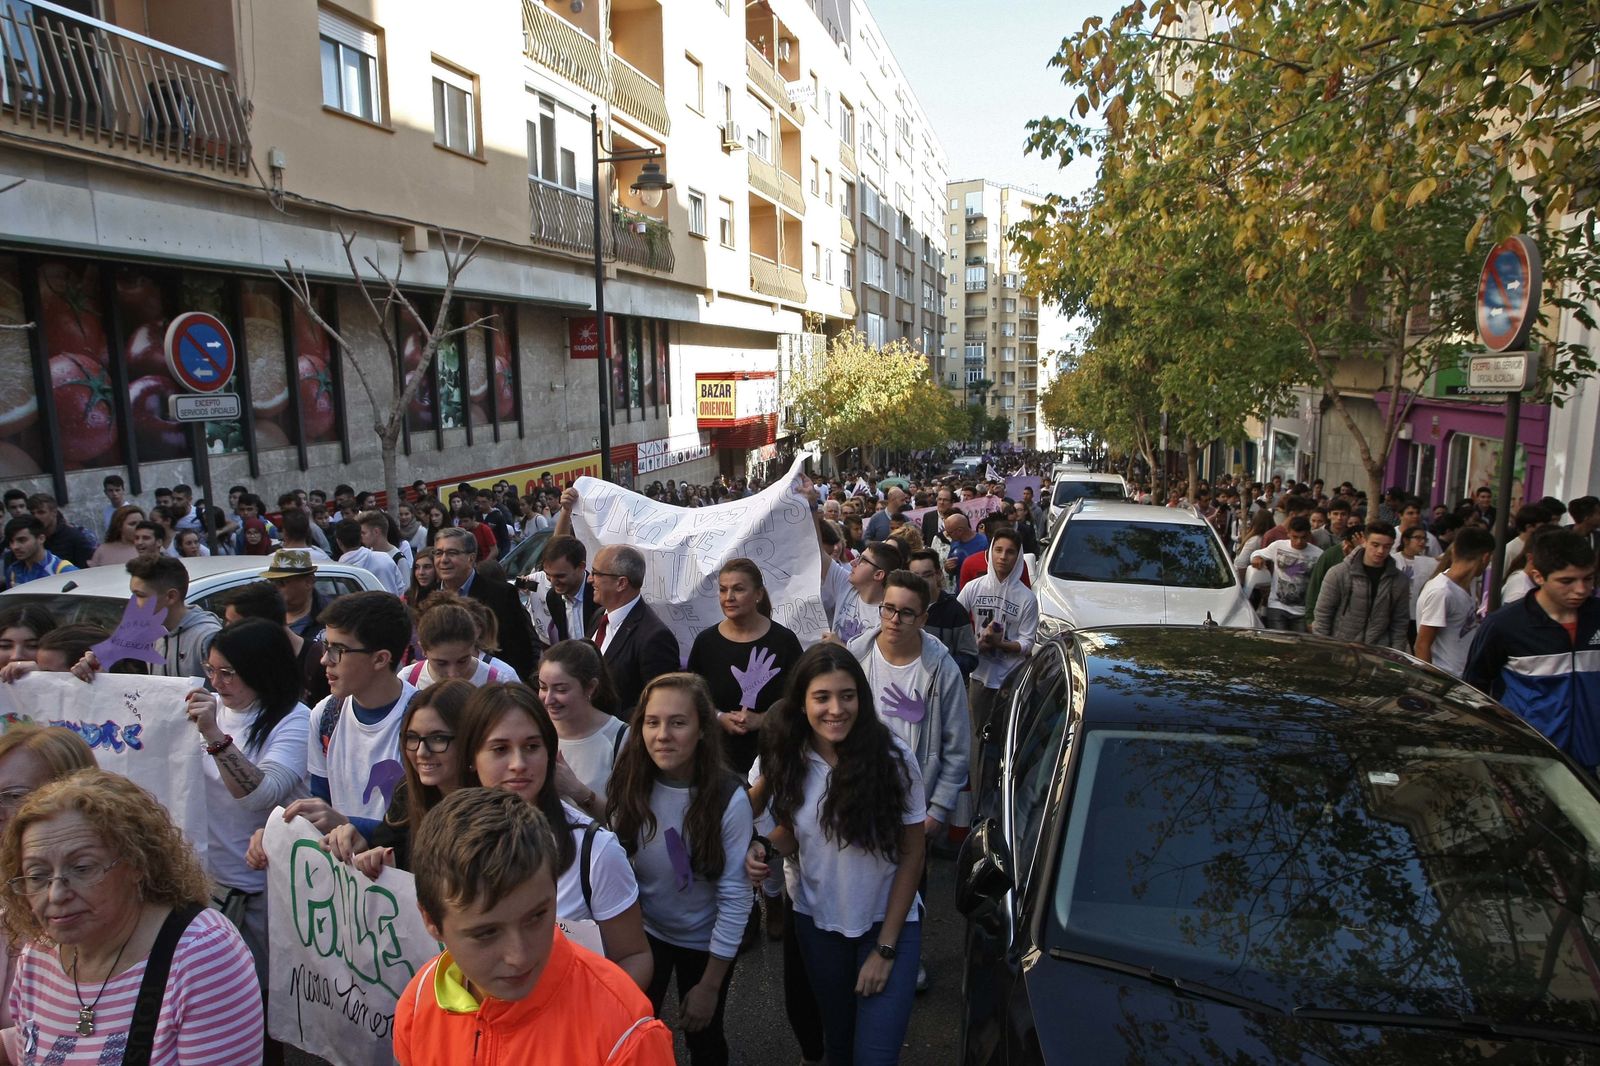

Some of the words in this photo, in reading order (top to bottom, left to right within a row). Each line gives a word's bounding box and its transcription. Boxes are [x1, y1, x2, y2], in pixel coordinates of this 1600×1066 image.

[701, 383, 732, 398] BAZAR
[195, 399, 221, 407] EXCEPTO
[699, 401, 733, 416] ORIENTAL
[180, 408, 209, 417] SERVICIOS
[210, 407, 237, 415] OFICIALES
[583, 484, 678, 546] UNA
[694, 506, 749, 529] VEZ
[976, 597, 997, 605] NEW
[290, 963, 334, 1043] para
